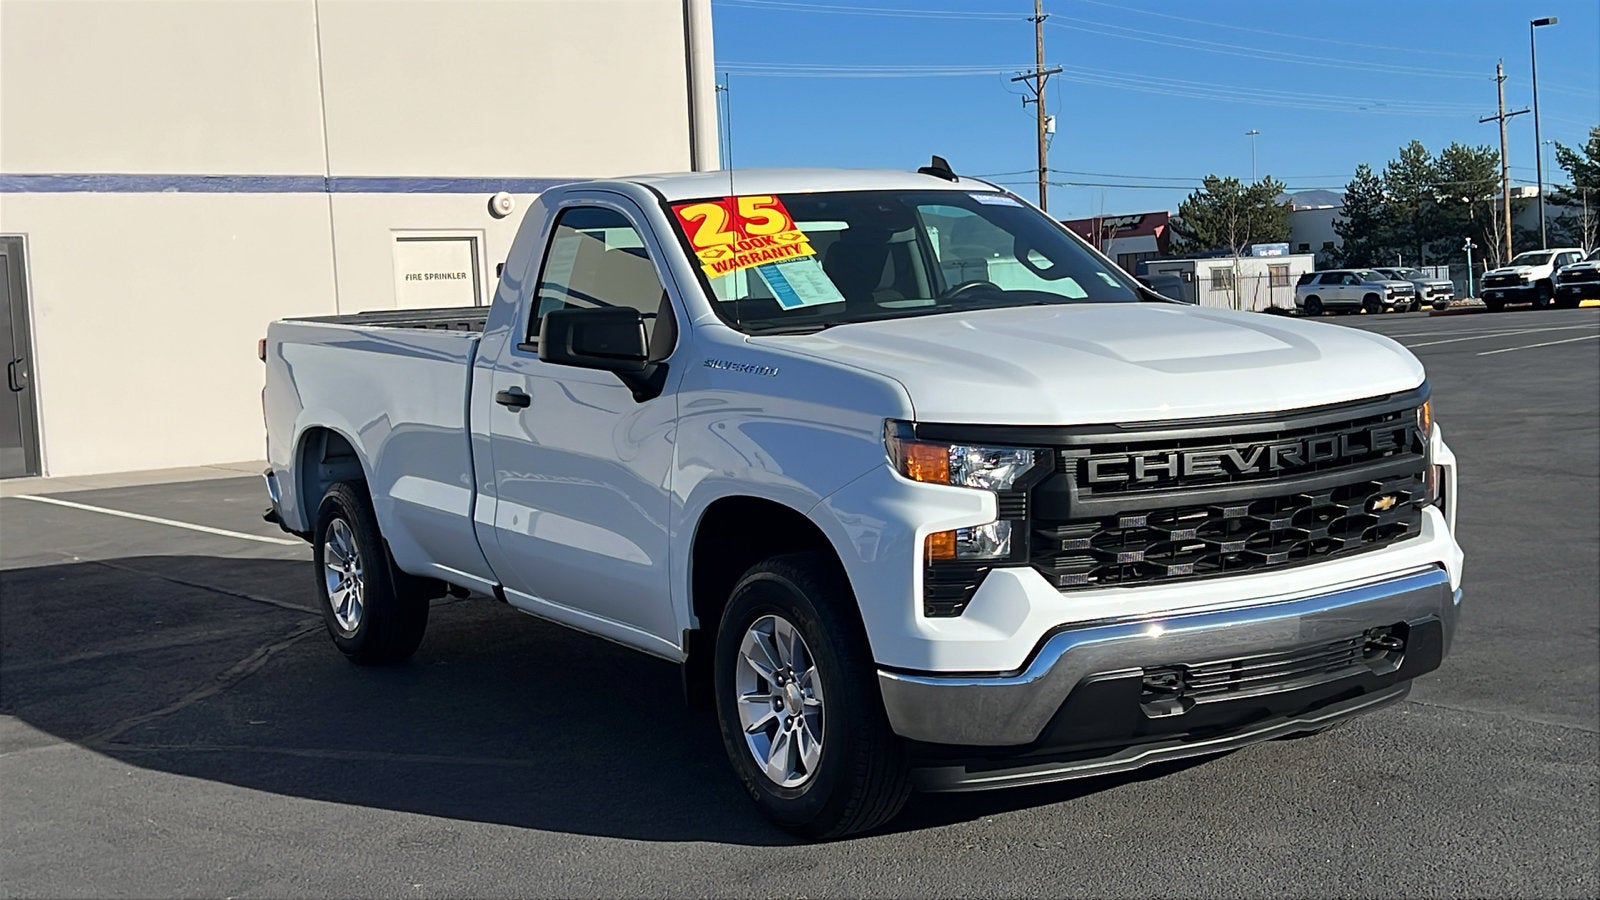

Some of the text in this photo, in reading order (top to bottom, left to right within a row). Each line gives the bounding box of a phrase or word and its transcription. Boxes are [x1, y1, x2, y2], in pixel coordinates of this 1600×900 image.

[679, 196, 791, 248] 25
[711, 242, 802, 274] WARRANTY
[726, 234, 779, 254] LOOK
[405, 272, 467, 281] FIRE SPRINKLER
[1088, 422, 1416, 484] CHEVROLET
